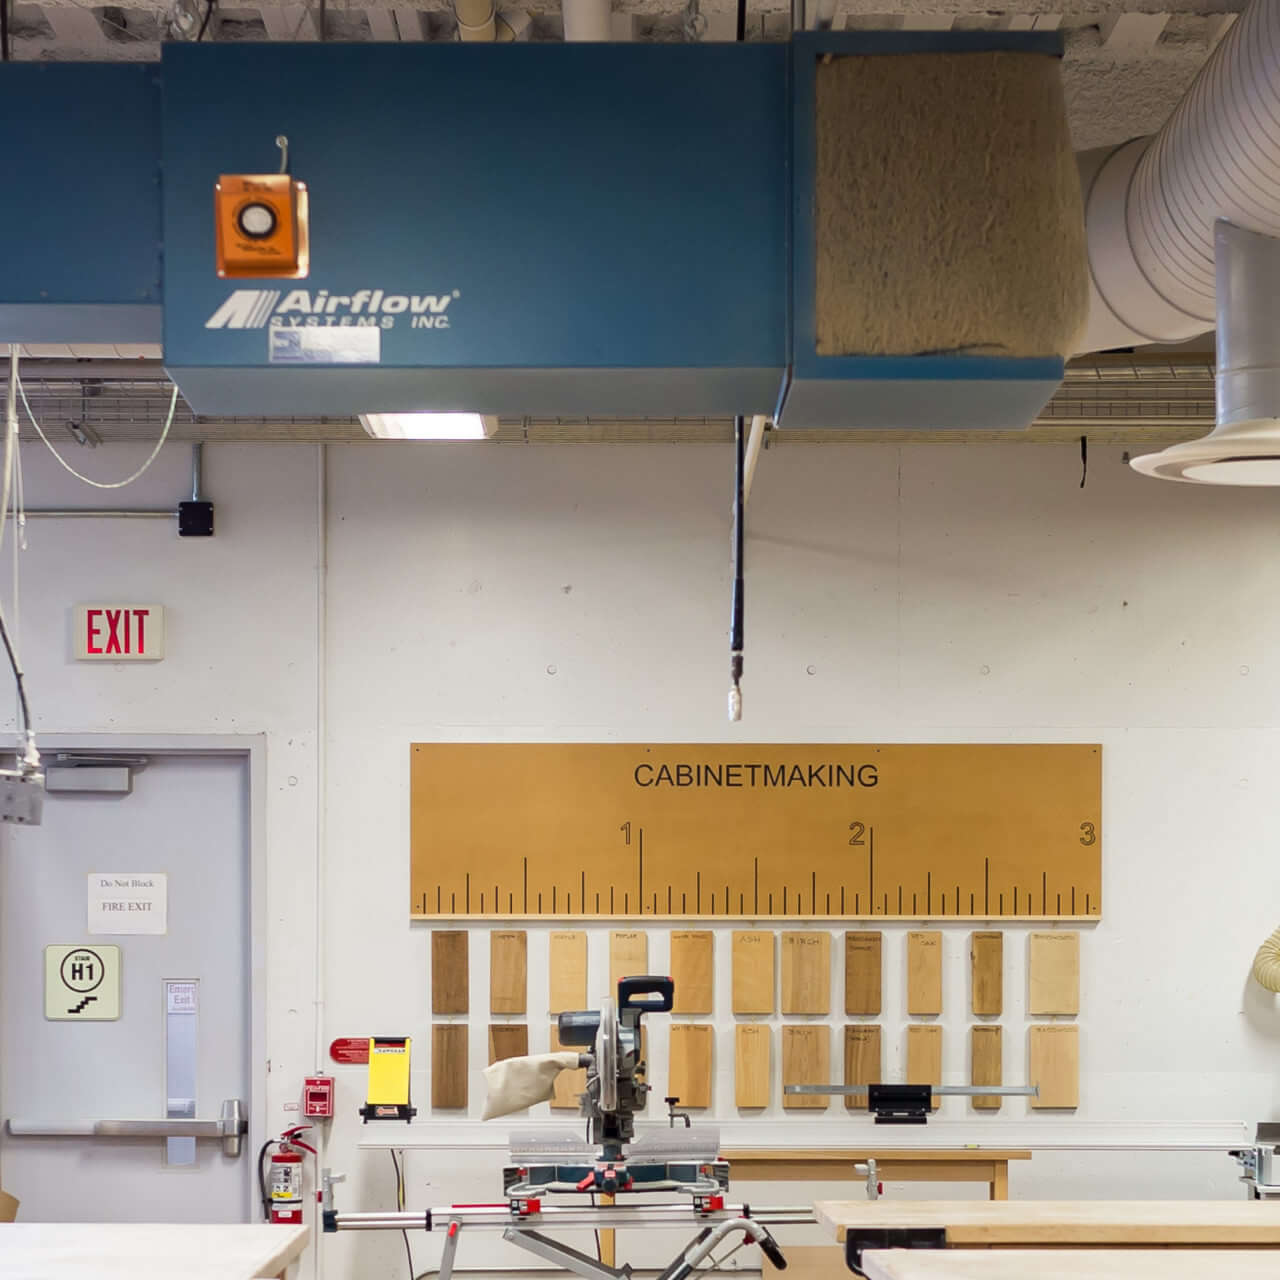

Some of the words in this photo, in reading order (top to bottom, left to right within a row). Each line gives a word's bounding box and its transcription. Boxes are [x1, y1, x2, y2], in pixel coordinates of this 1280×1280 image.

[275, 289, 452, 314] Airflow
[270, 315, 395, 329] SYSTEMS
[86, 608, 150, 655] EXIT
[633, 763, 880, 788] CABINETMAKING
[619, 821, 632, 846] 1
[848, 821, 866, 846] 2
[1079, 821, 1097, 846] 3
[100, 879, 113, 888] Do
[114, 879, 129, 888] Not
[131, 879, 154, 888] Block
[102, 902, 125, 912] FIRE
[128, 902, 153, 912] EXIT
[71, 962, 94, 981] H1
